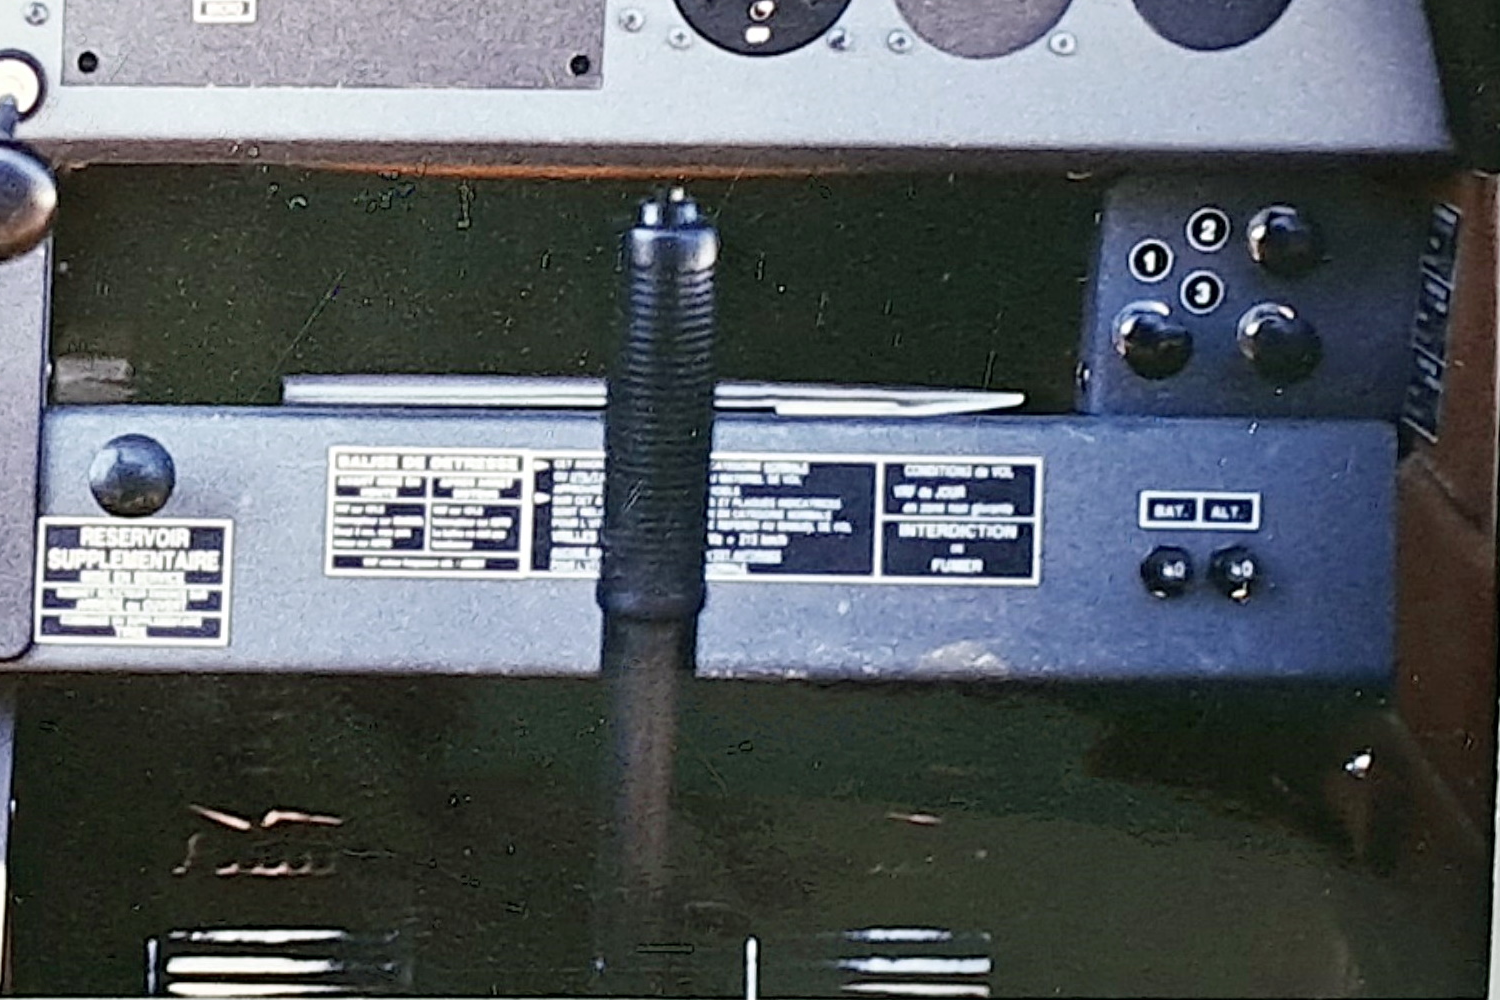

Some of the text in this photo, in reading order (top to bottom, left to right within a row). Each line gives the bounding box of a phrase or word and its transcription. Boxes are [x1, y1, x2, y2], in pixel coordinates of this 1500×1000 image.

[1201, 219, 1216, 241] 2
[1143, 250, 1157, 273] 1
[1195, 281, 1211, 304] 3
[79, 526, 191, 548] RESERVOIR
[899, 523, 1018, 540] INTERDICTION
[47, 547, 220, 571] SUPPLEMENTAIRE
